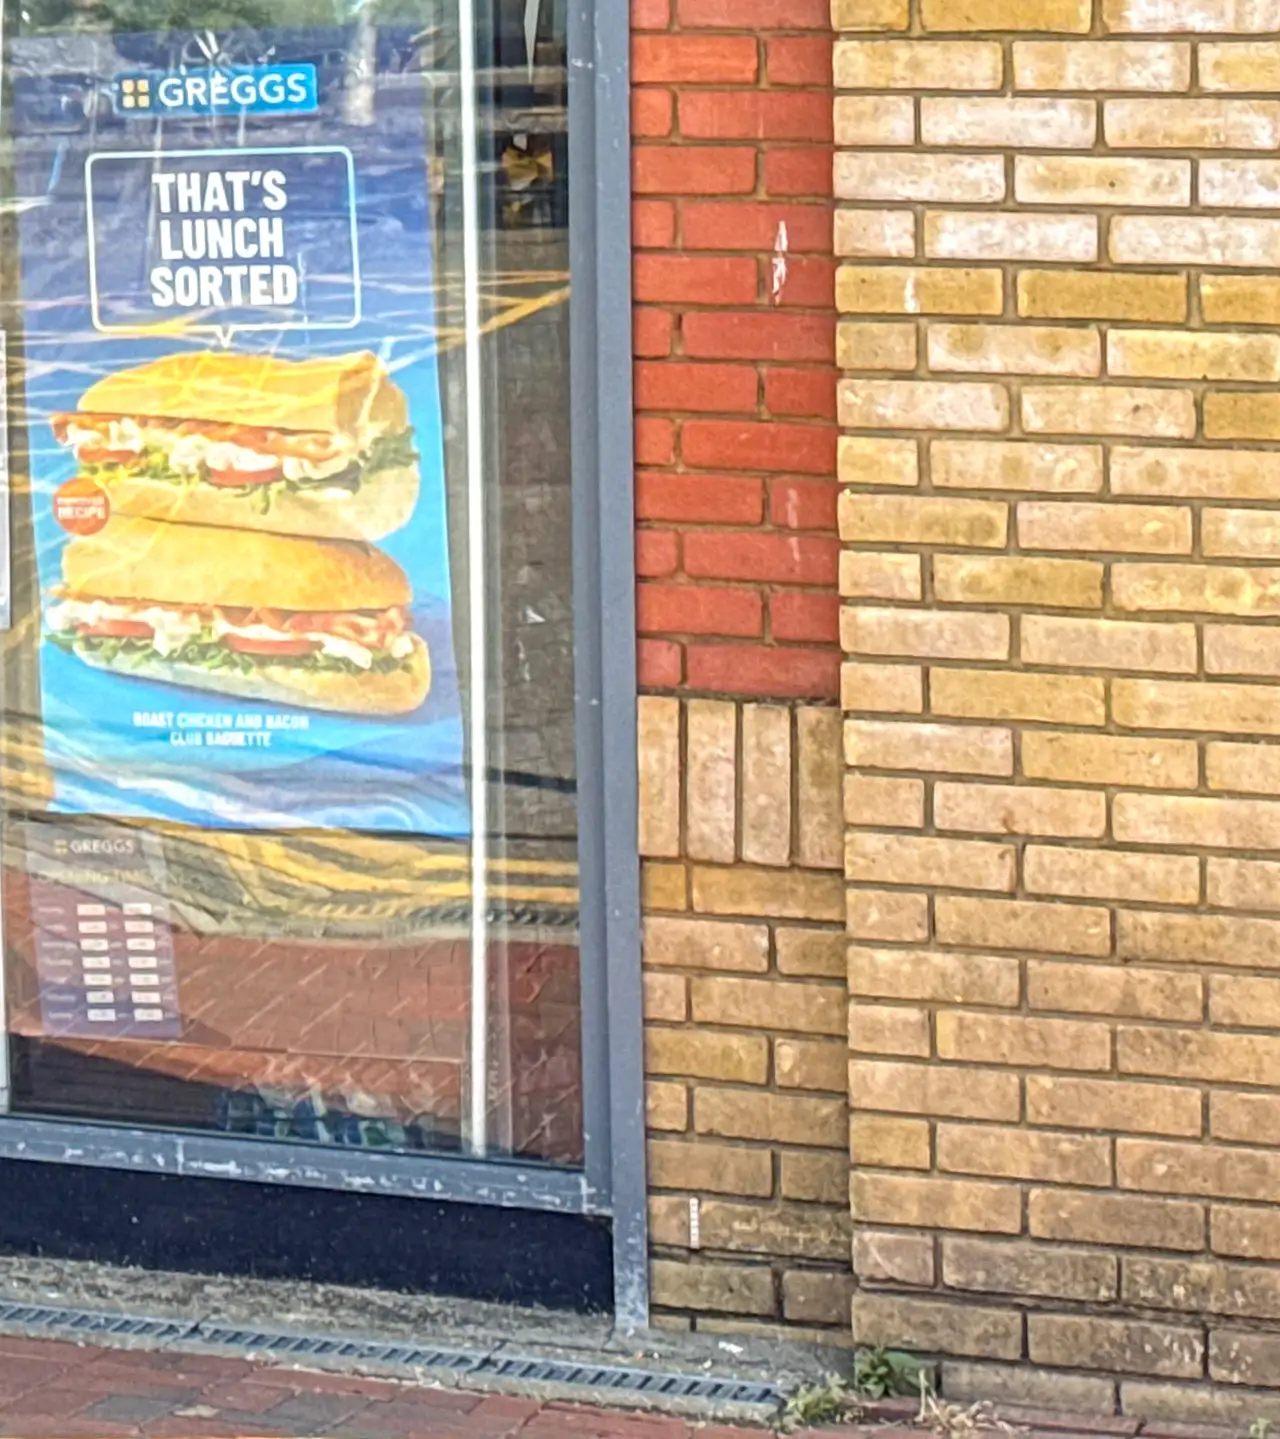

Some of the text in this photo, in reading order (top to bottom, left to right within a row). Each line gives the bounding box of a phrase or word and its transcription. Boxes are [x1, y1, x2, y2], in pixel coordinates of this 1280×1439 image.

[158, 72, 308, 108] GREGGS
[152, 170, 288, 214] THAT'S
[159, 218, 285, 261] LUNCH
[150, 264, 298, 308] SORTED
[70, 837, 135, 855] GREGGS
